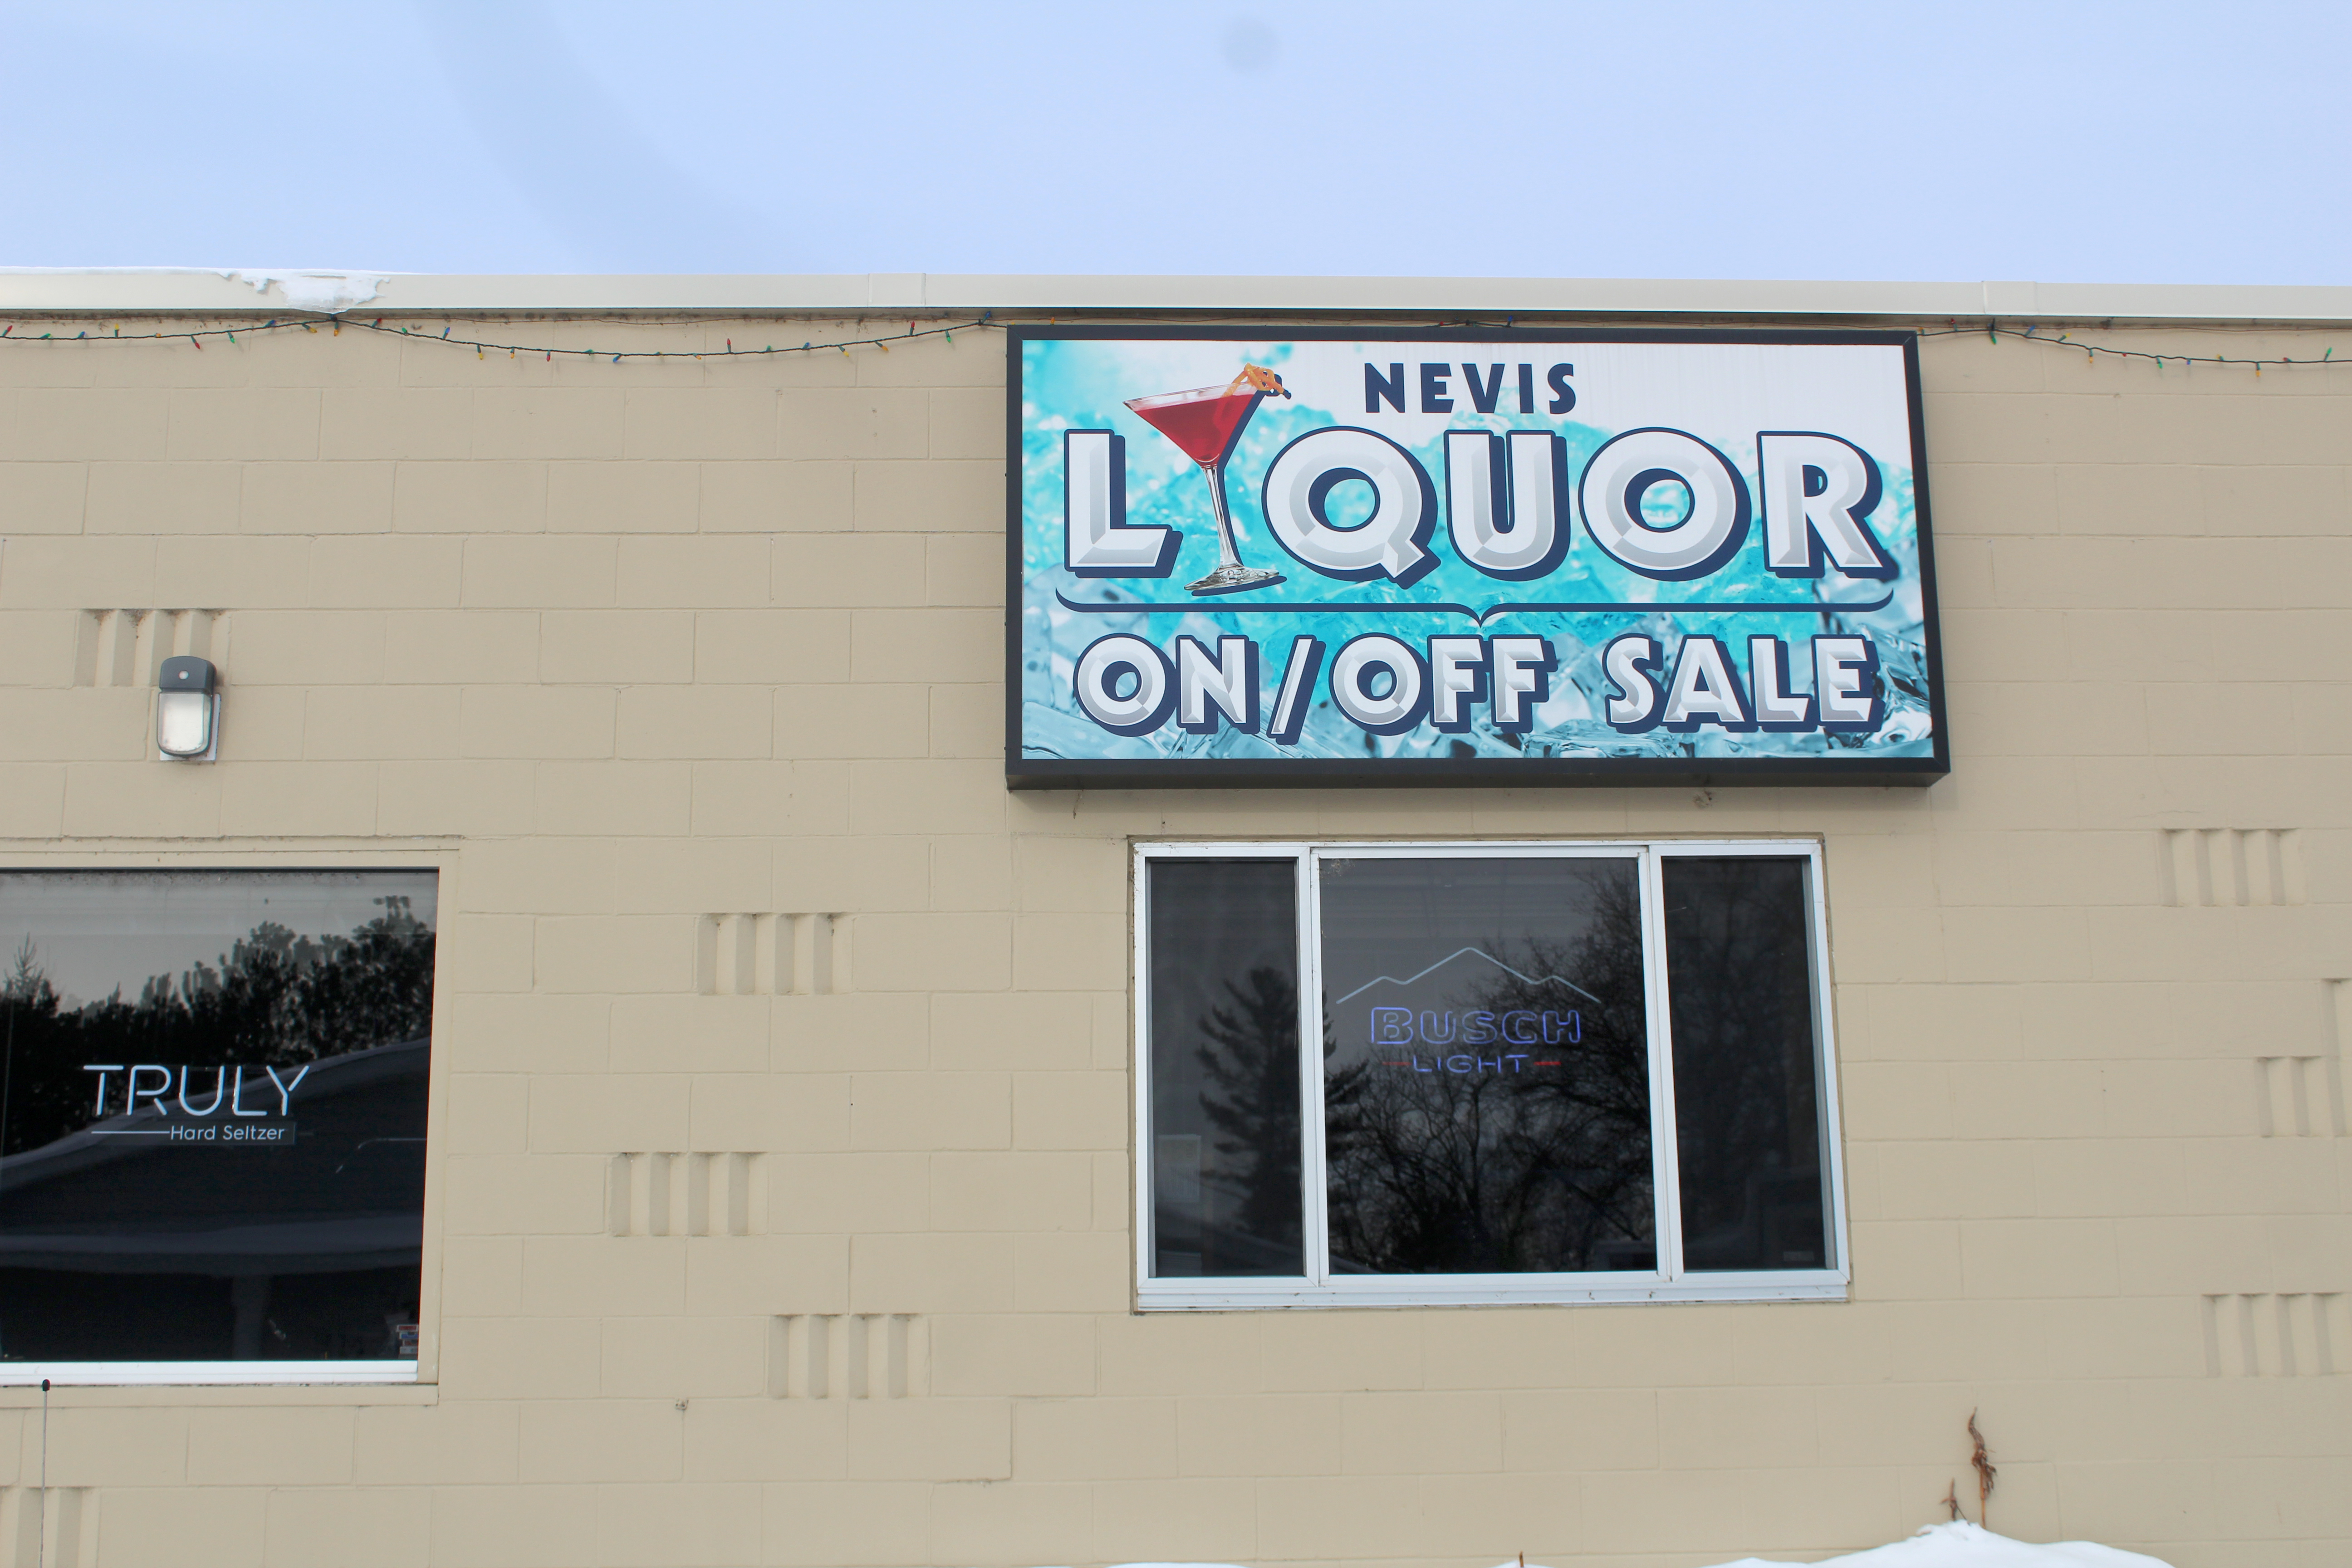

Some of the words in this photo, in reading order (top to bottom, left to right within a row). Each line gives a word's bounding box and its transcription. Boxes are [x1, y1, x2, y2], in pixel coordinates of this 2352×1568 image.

[1365, 361, 1578, 414] NEVIS
[1063, 425, 1900, 590] LIQUOR
[1072, 631, 1559, 745] ON/OFF
[1602, 632, 1884, 734] SALE
[1371, 1006, 1581, 1045] BUSCH
[83, 1064, 310, 1117] TRULY
[1413, 1054, 1529, 1074] LIGHT
[170, 1125, 216, 1141] Hard
[223, 1125, 285, 1141] Seltzer
